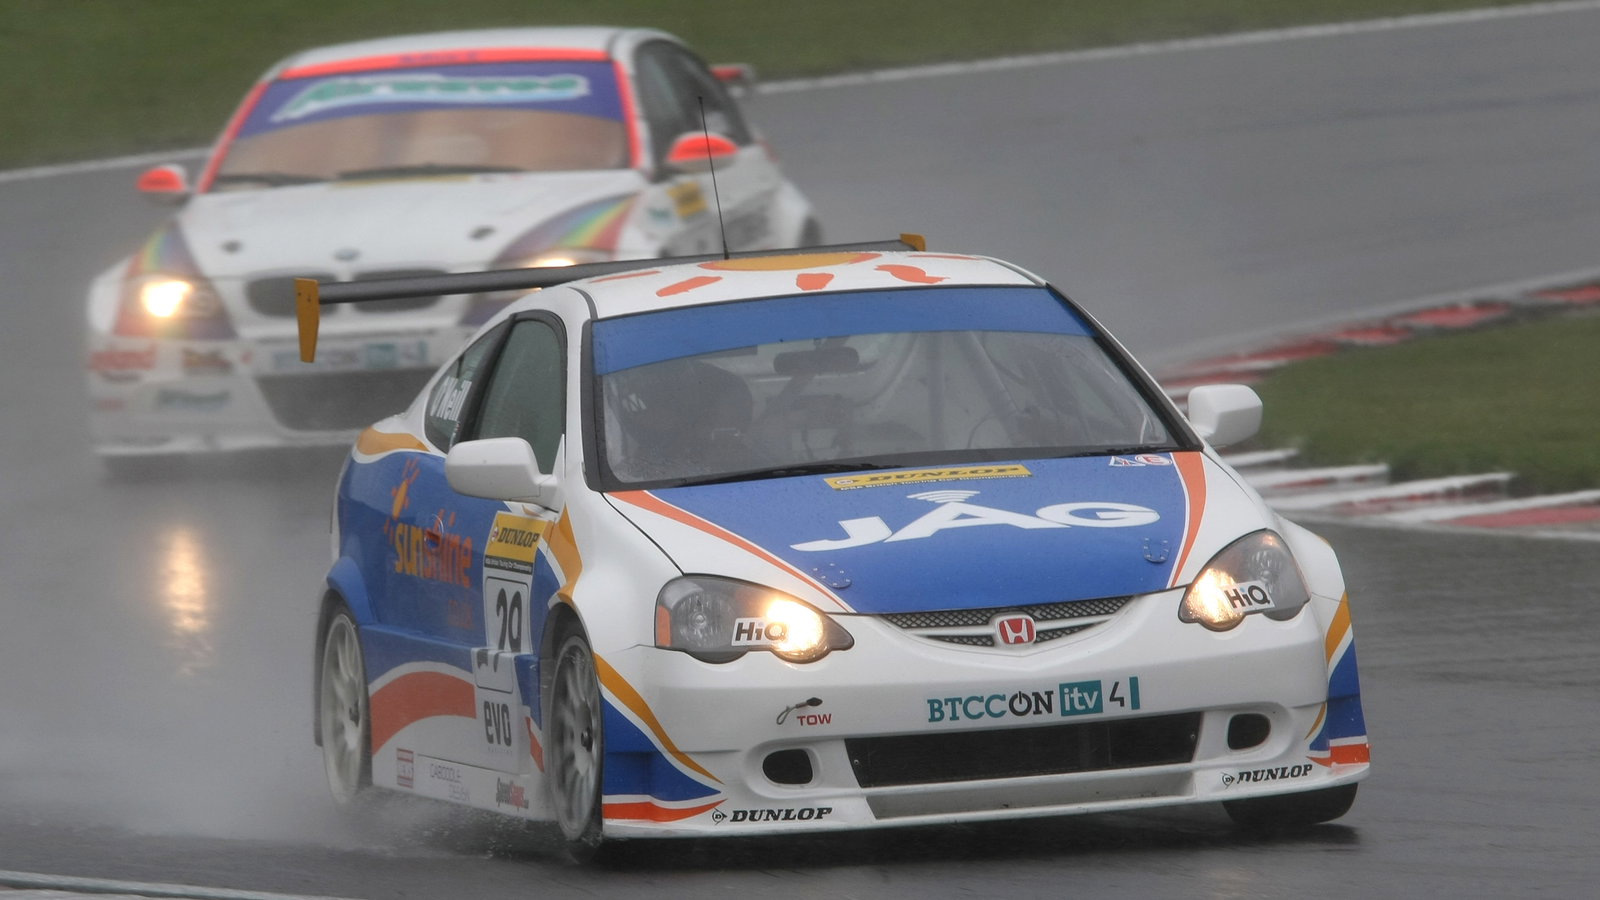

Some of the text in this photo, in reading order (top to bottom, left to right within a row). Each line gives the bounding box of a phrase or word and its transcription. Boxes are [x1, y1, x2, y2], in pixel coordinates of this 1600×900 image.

[867, 467, 1019, 482] DUNLOP
[791, 502, 1160, 551] JAG
[497, 527, 540, 548] DUNLOP
[395, 510, 472, 588] sunshine
[1224, 585, 1271, 608] HiQ
[735, 622, 787, 641] HiQ
[1063, 686, 1099, 712] itv
[1109, 681, 1125, 708] 4
[484, 701, 512, 747] evo
[796, 713, 832, 726] TOW
[1237, 764, 1313, 785] DUNLOP
[730, 807, 833, 822] DUNLOP
